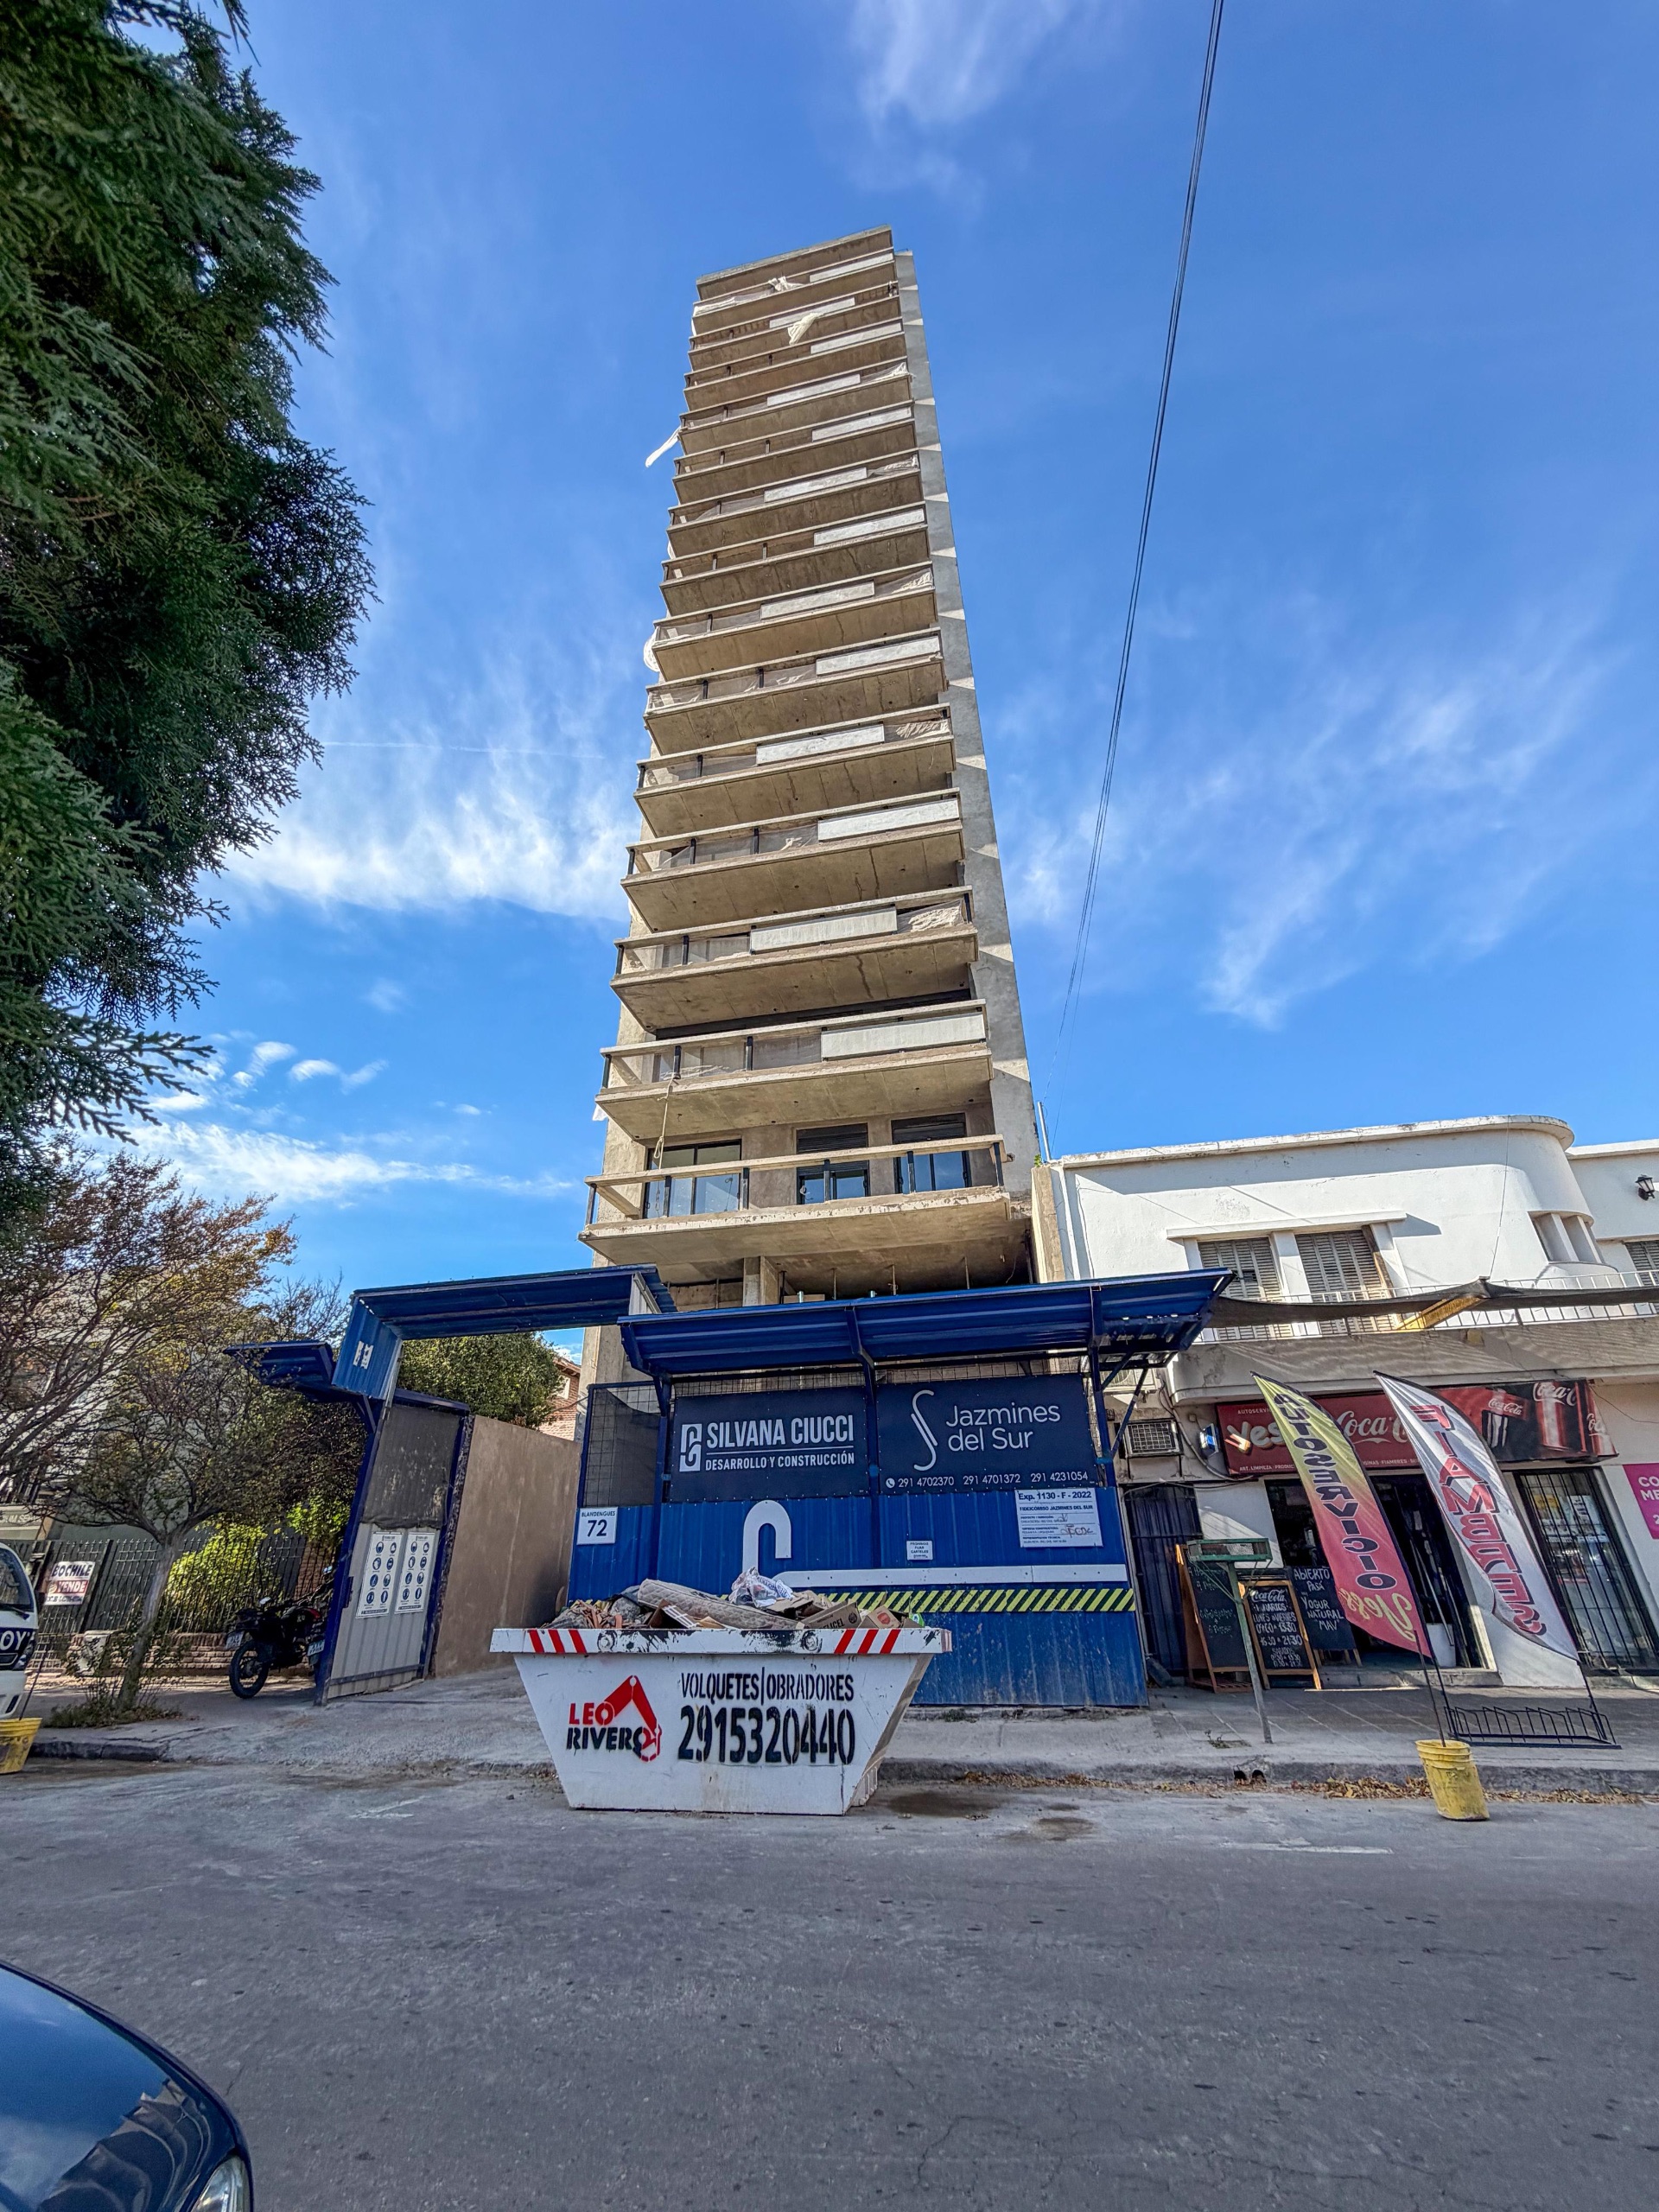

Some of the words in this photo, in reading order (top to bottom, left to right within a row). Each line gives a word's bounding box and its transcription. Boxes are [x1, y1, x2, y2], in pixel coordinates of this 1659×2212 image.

[945, 1402, 1061, 1427] Jazmines
[706, 1419, 786, 1449] SILVANA
[791, 1414, 854, 1445] CIUCCI
[947, 1427, 984, 1452] del
[992, 1427, 1033, 1450] Sur
[705, 1457, 767, 1471] DESARROLLO
[769, 1457, 775, 1468] Y
[778, 1451, 855, 1468] CONSTRUCCIÓN
[898, 1478, 913, 1488] 291
[917, 1476, 955, 1487] 4702370
[963, 1475, 978, 1485] 291
[982, 1473, 1020, 1484] 4701372
[1030, 1472, 1046, 1483] 291
[1050, 1471, 1089, 1481] 4231054
[588, 1519, 607, 1537] 72
[52, 1565, 92, 1577] BOCHILE
[58, 1580, 87, 1593] VENDE
[1300, 1596, 1331, 1610] YOGUR
[1306, 1610, 1344, 1619] NATURAL
[680, 1672, 760, 1703] VOLQUETES
[766, 1674, 855, 1701] OBRADORES
[569, 1701, 615, 1726] LEO
[677, 1704, 856, 1765] 2915320440
